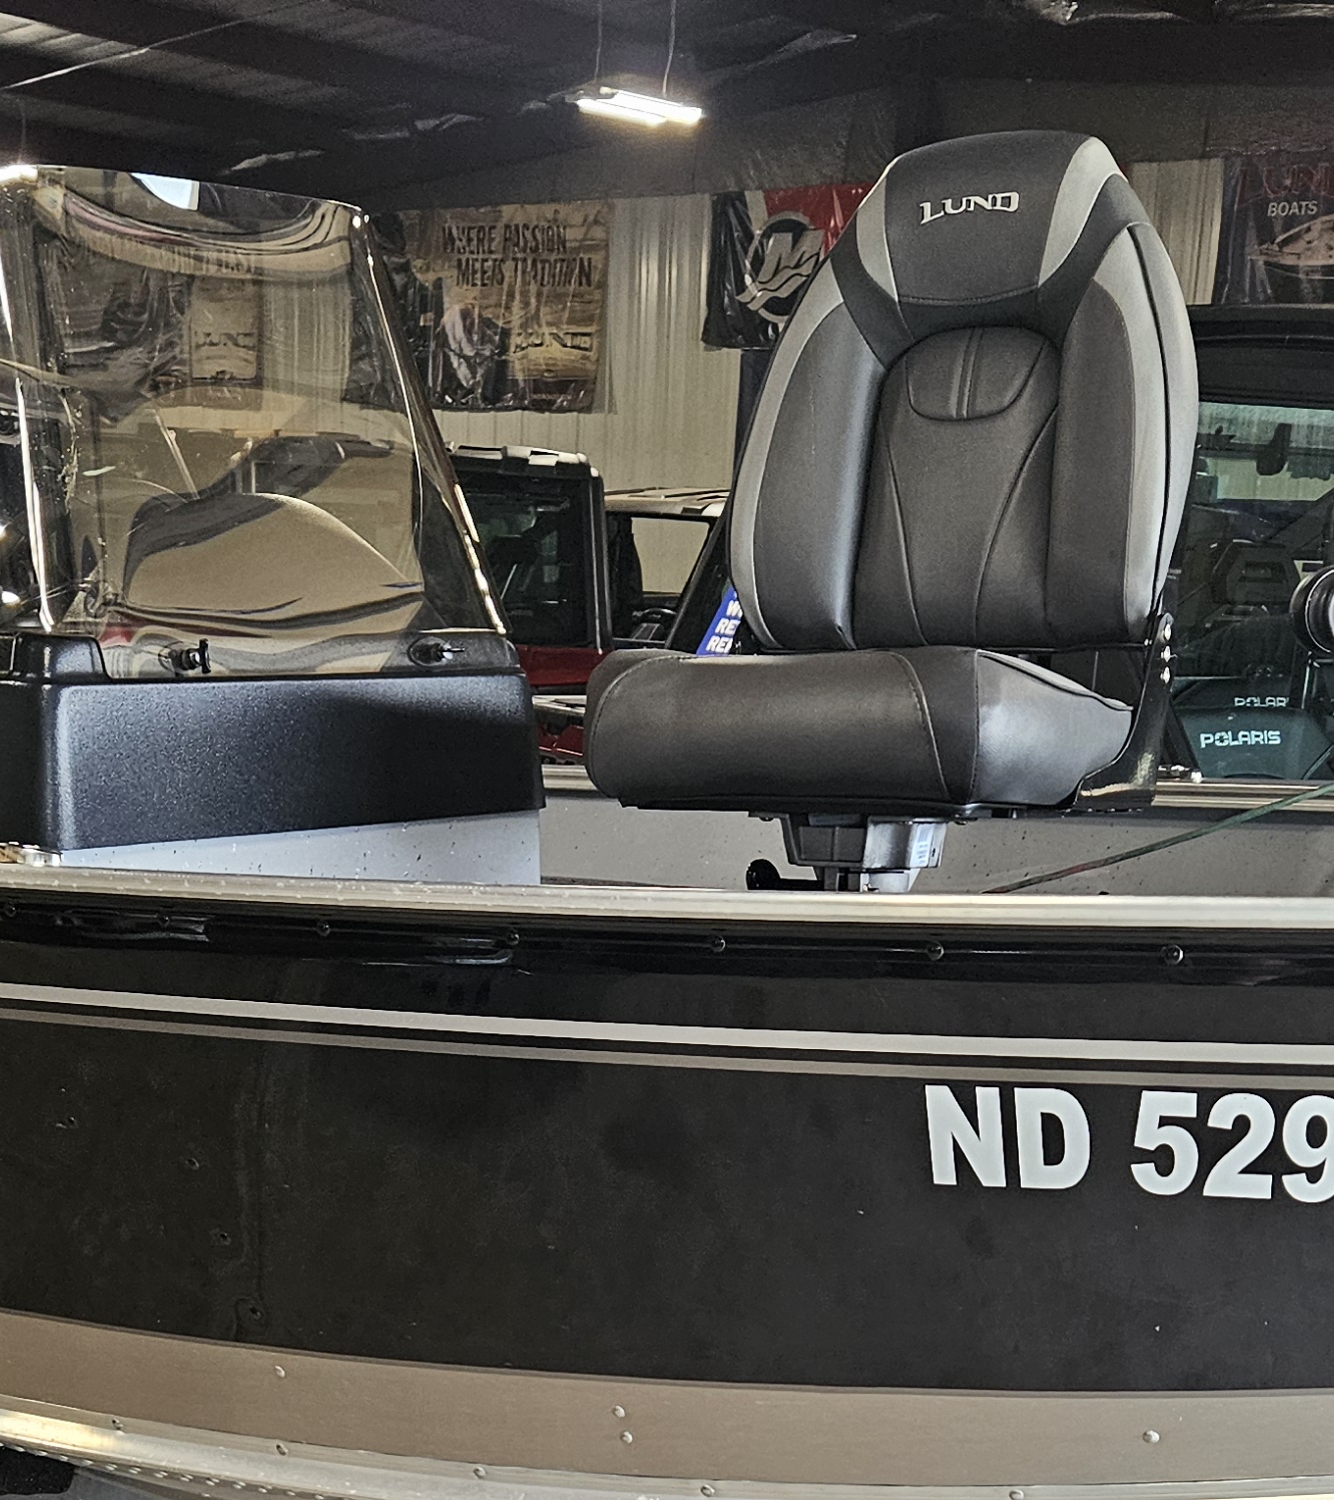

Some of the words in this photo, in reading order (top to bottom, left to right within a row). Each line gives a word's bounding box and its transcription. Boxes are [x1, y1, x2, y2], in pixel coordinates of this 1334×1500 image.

[919, 191, 1020, 225] LUND
[1267, 201, 1318, 217] BOATS
[441, 225, 497, 255] WHERE
[503, 223, 568, 255] PASSION
[455, 257, 505, 288] MEETS
[1234, 697, 1290, 707] POLAR
[1199, 730, 1282, 748] POLARIS
[924, 1085, 1091, 1190] ND
